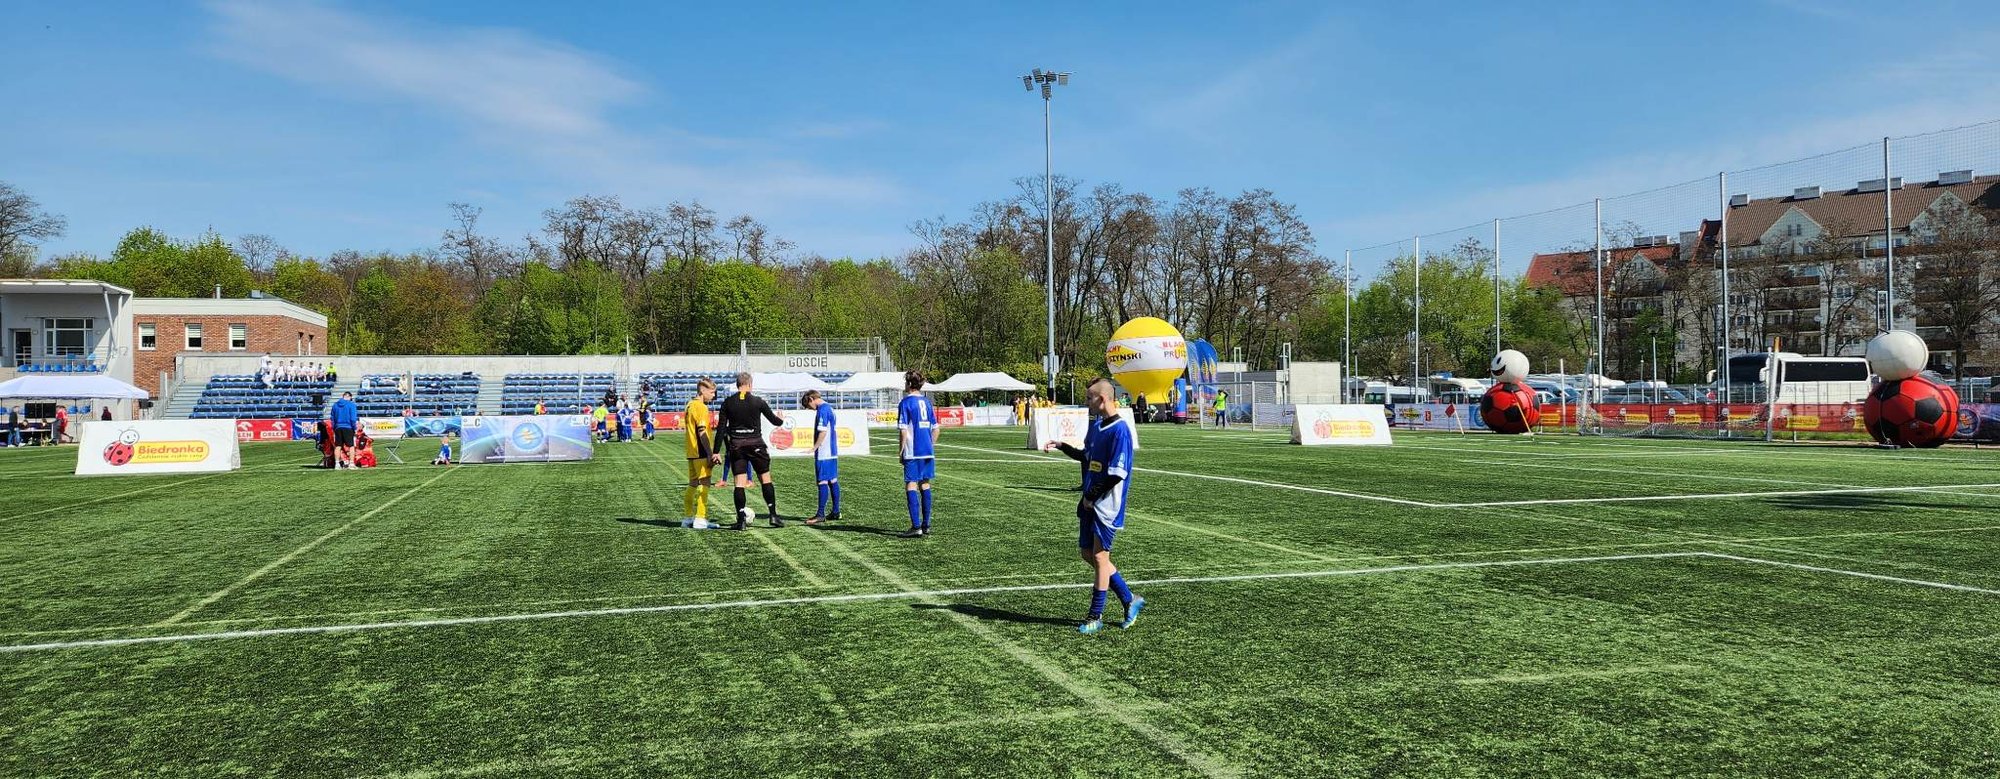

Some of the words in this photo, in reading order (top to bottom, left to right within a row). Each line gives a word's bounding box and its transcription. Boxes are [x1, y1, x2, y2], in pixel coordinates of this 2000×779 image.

[919, 399, 928, 420] 8
[474, 418, 481, 427] C
[138, 445, 204, 454] Biedronka
